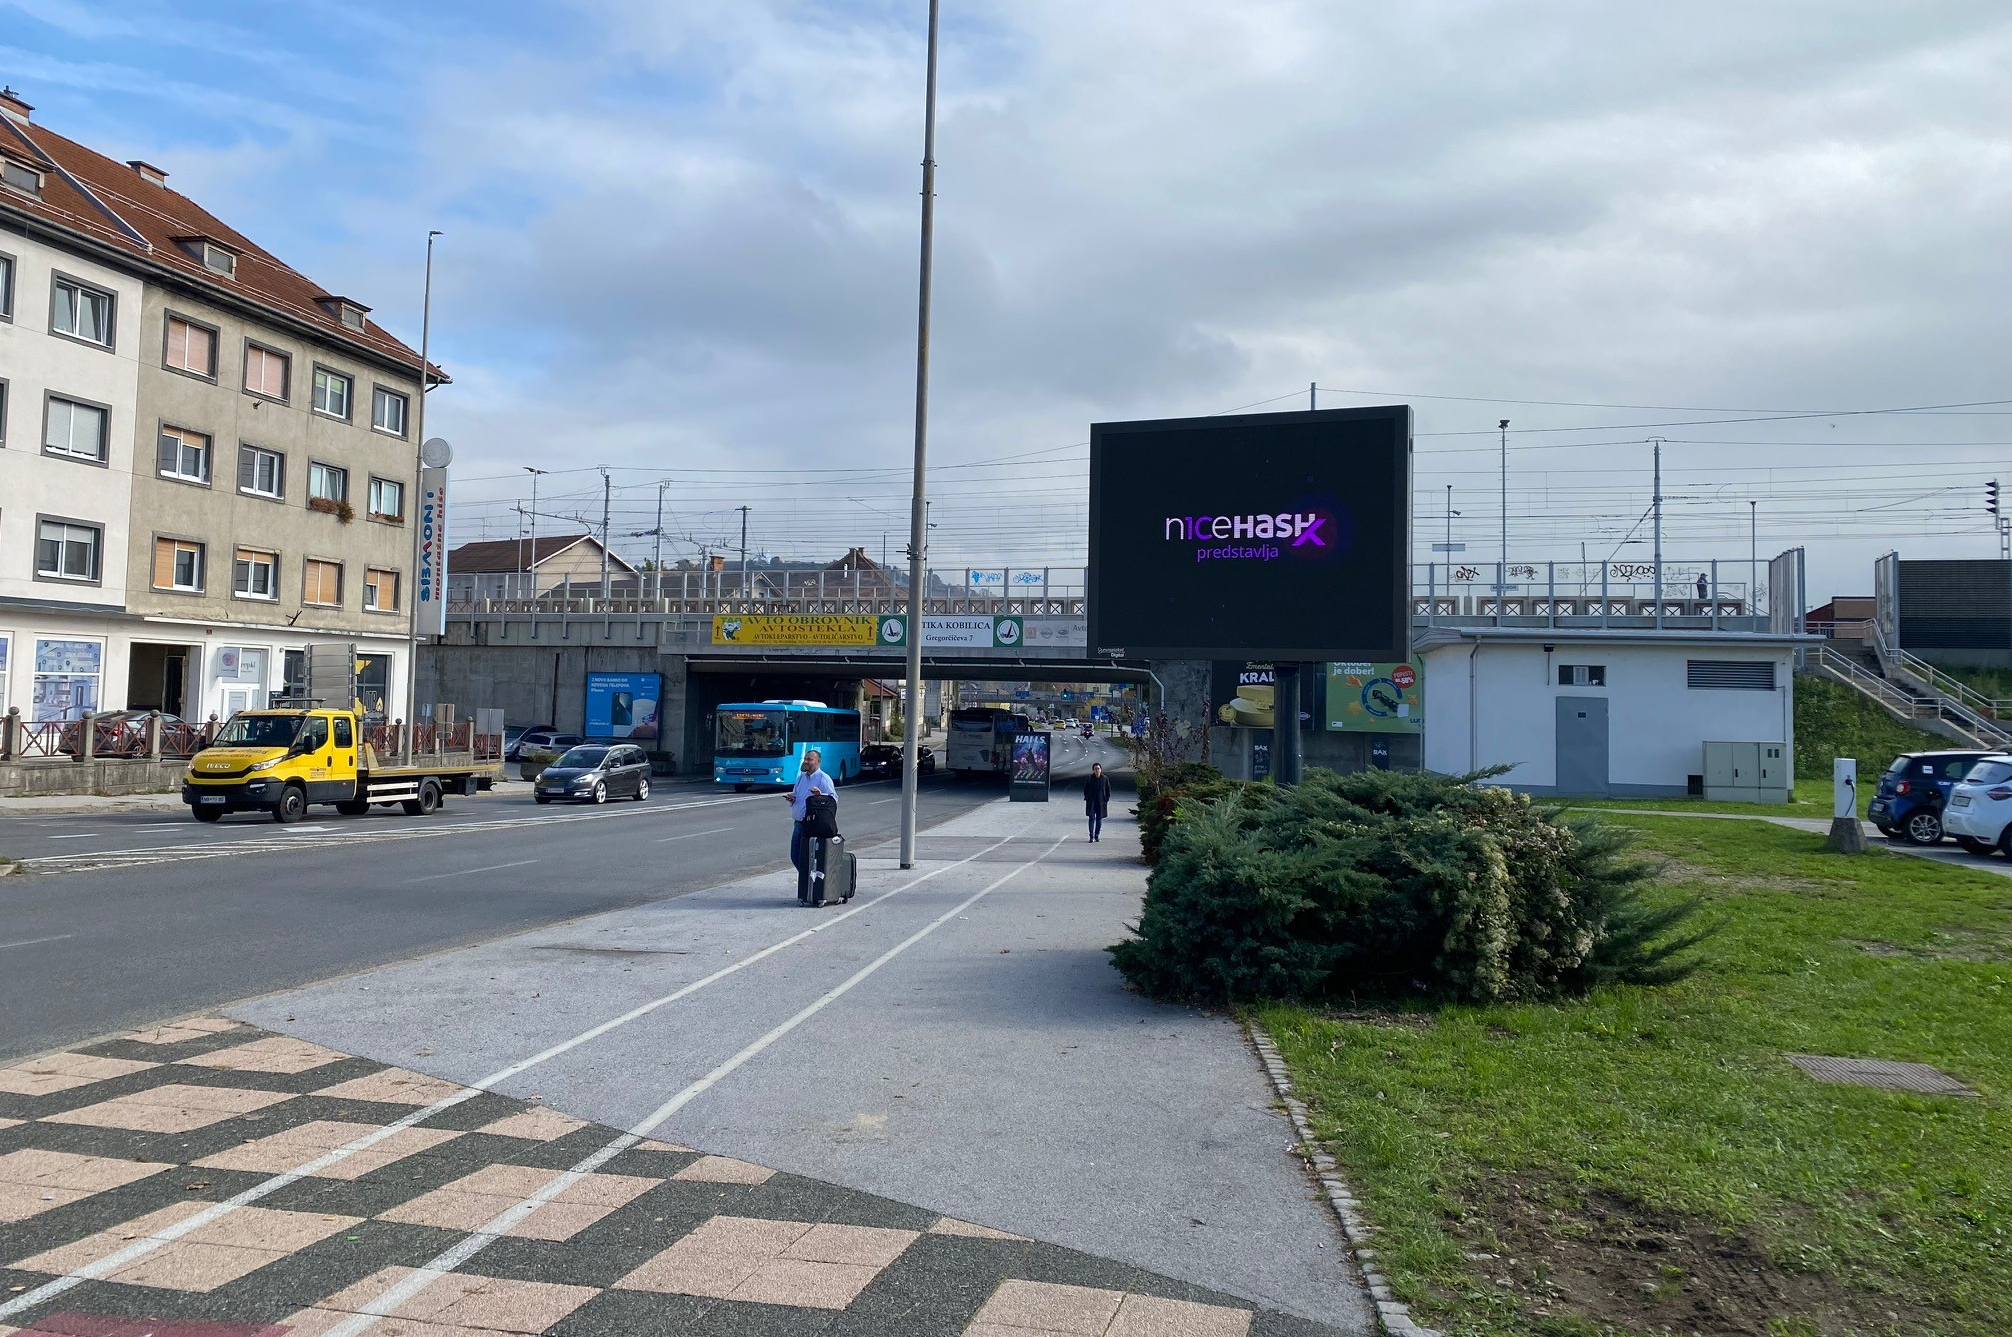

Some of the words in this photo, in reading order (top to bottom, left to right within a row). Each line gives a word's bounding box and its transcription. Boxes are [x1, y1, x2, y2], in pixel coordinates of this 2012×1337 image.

[1197, 544, 1279, 562] predstavlja
[745, 616, 785, 625] AVTO
[788, 616, 873, 625] OBROVNIK
[759, 625, 857, 633] AVTOSTEKLA
[921, 621, 944, 629] TIKA
[945, 621, 991, 630] KOBILICA
[925, 634, 968, 643] Gregorčičeva
[1333, 666, 1342, 676] je
[1344, 667, 1375, 675] dober!
[1015, 735, 1047, 744] HALLS
